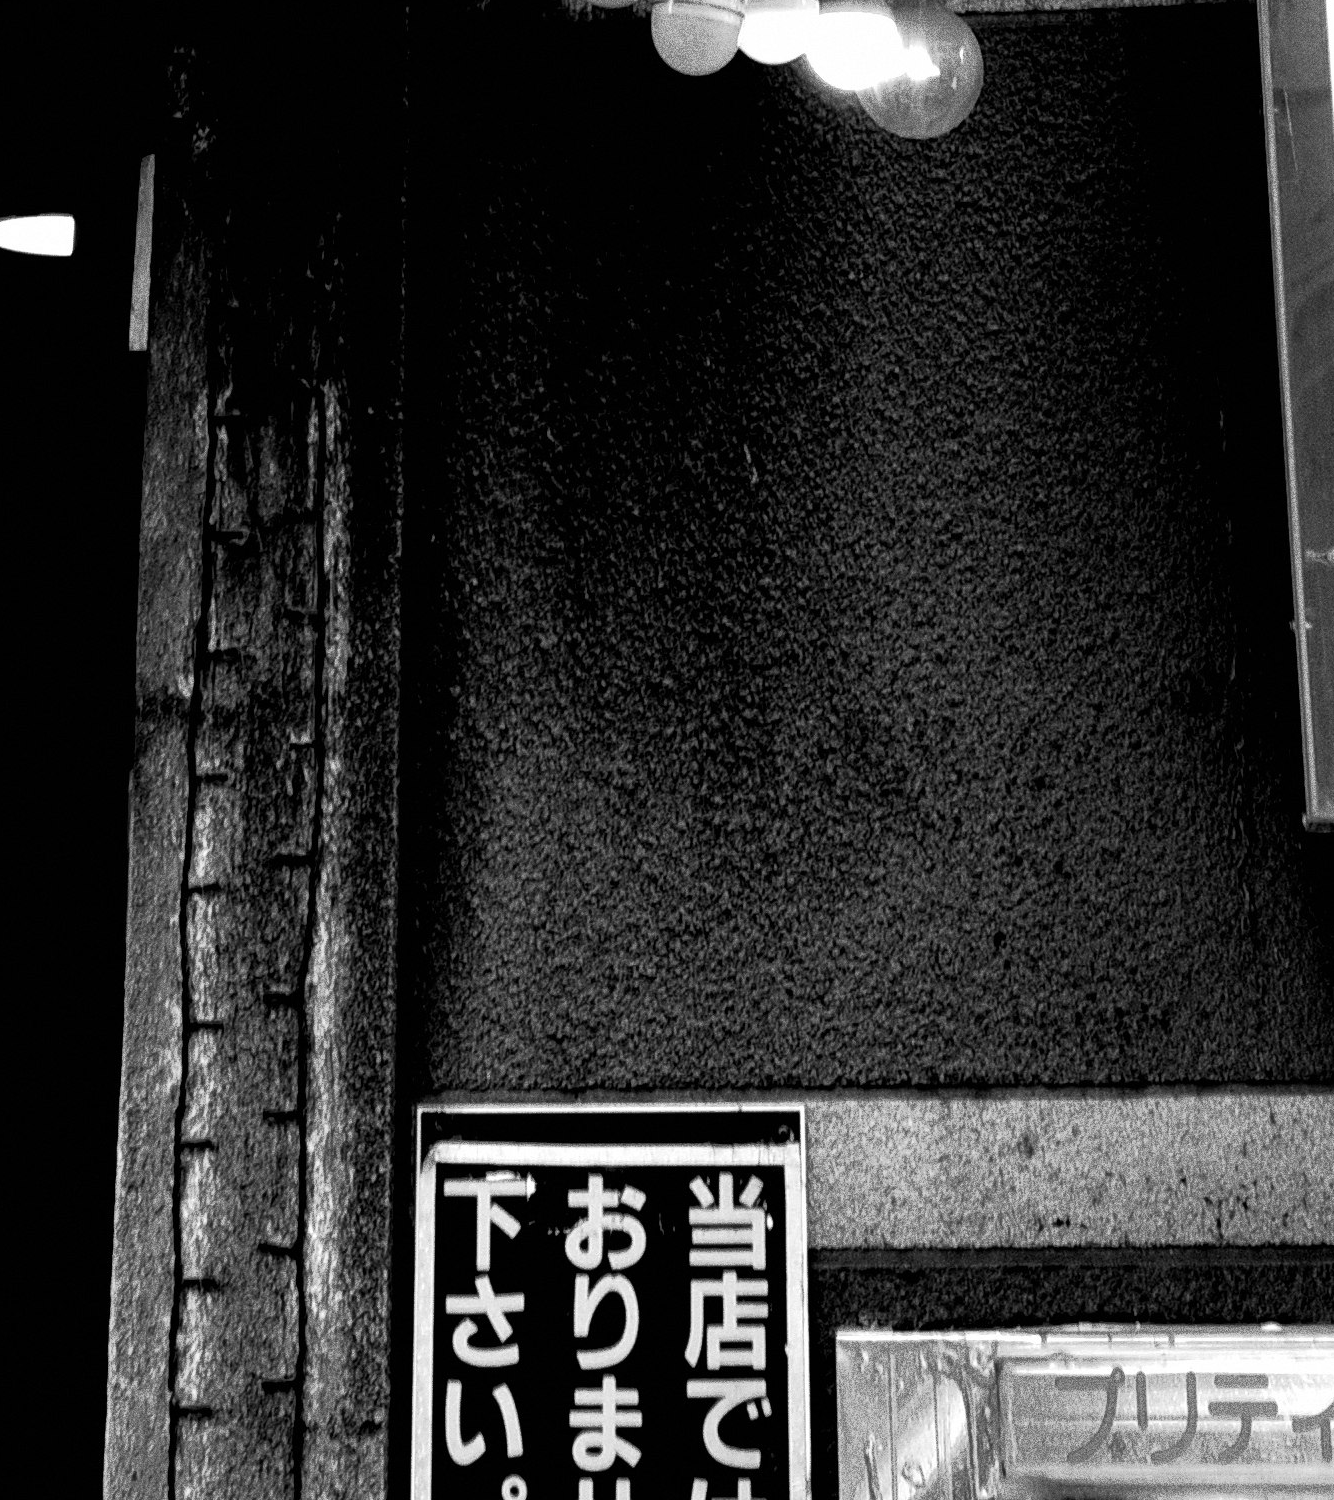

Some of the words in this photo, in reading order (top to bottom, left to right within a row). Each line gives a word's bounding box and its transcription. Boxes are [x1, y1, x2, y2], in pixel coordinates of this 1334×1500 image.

[565, 1173, 647, 1500] おりま
[685, 1171, 772, 1500] 当店で
